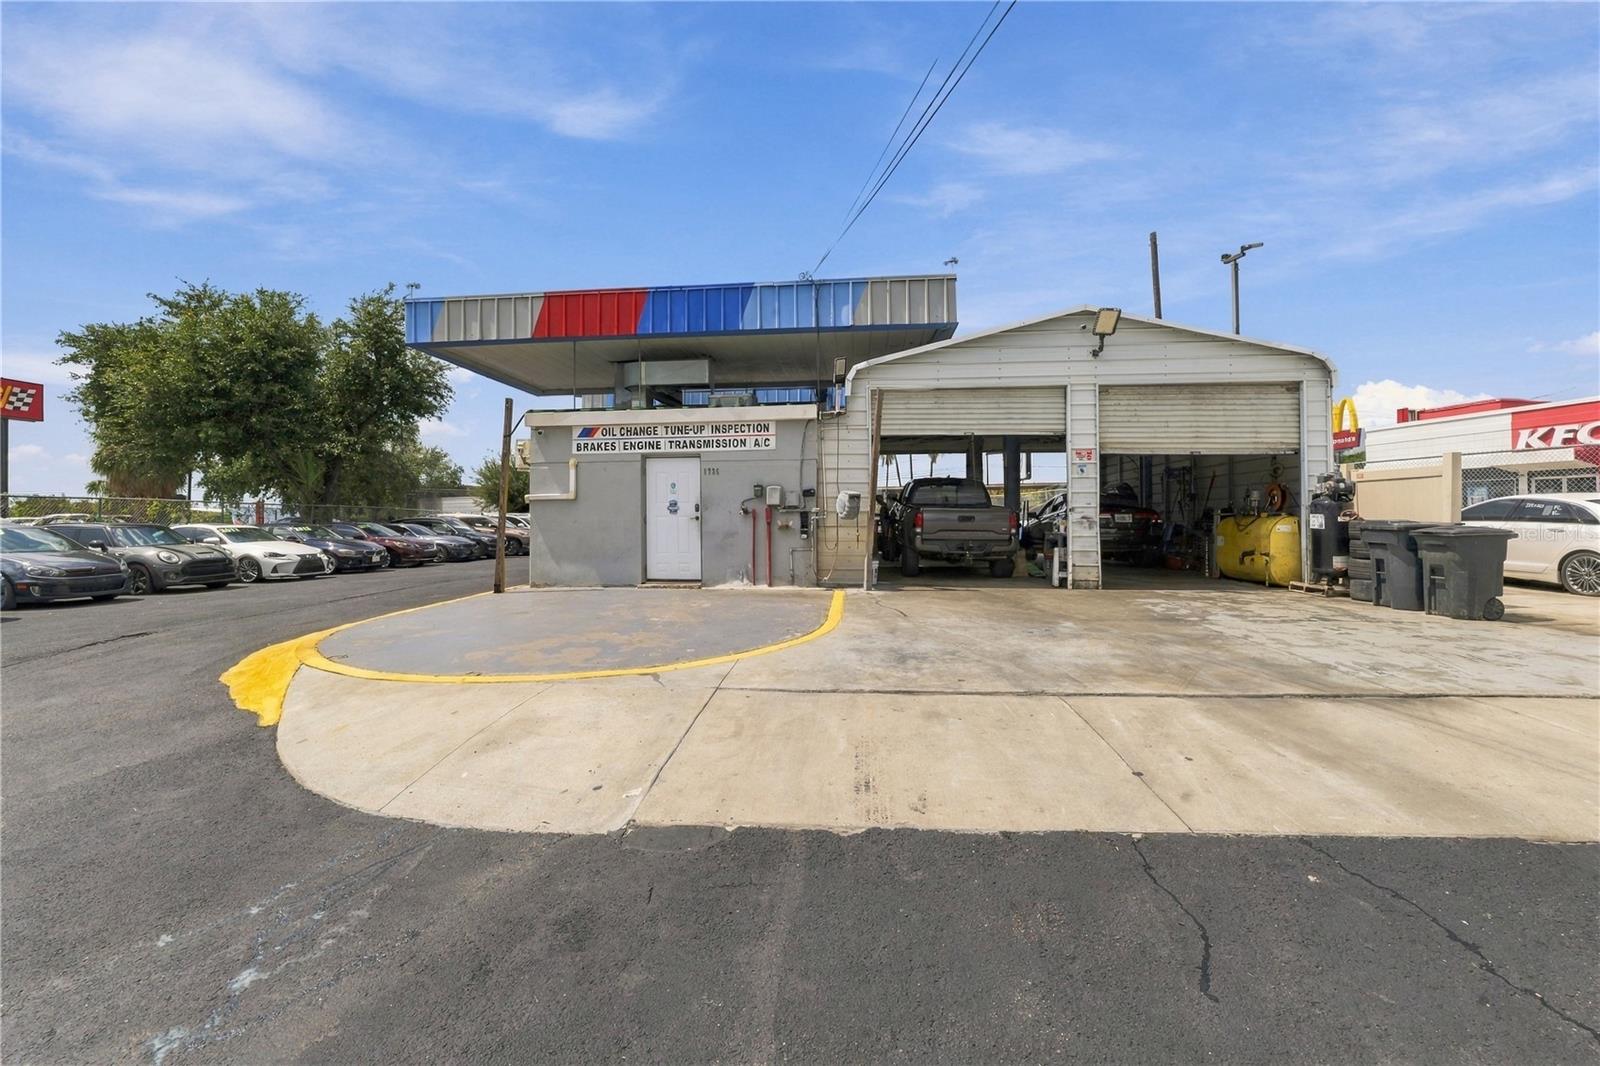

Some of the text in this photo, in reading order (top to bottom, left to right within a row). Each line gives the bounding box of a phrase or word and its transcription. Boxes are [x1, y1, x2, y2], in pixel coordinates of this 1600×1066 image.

[601, 426, 659, 437] OIL CHANGE
[664, 425, 706, 435] TUNE-UP
[711, 423, 770, 434] INSPECTION
[1515, 421, 1600, 450] KFC
[576, 441, 617, 452] BRAKES
[623, 440, 662, 450] ENGINE
[668, 438, 747, 449] TRANSMISSION
[754, 438, 770, 448] A/C
